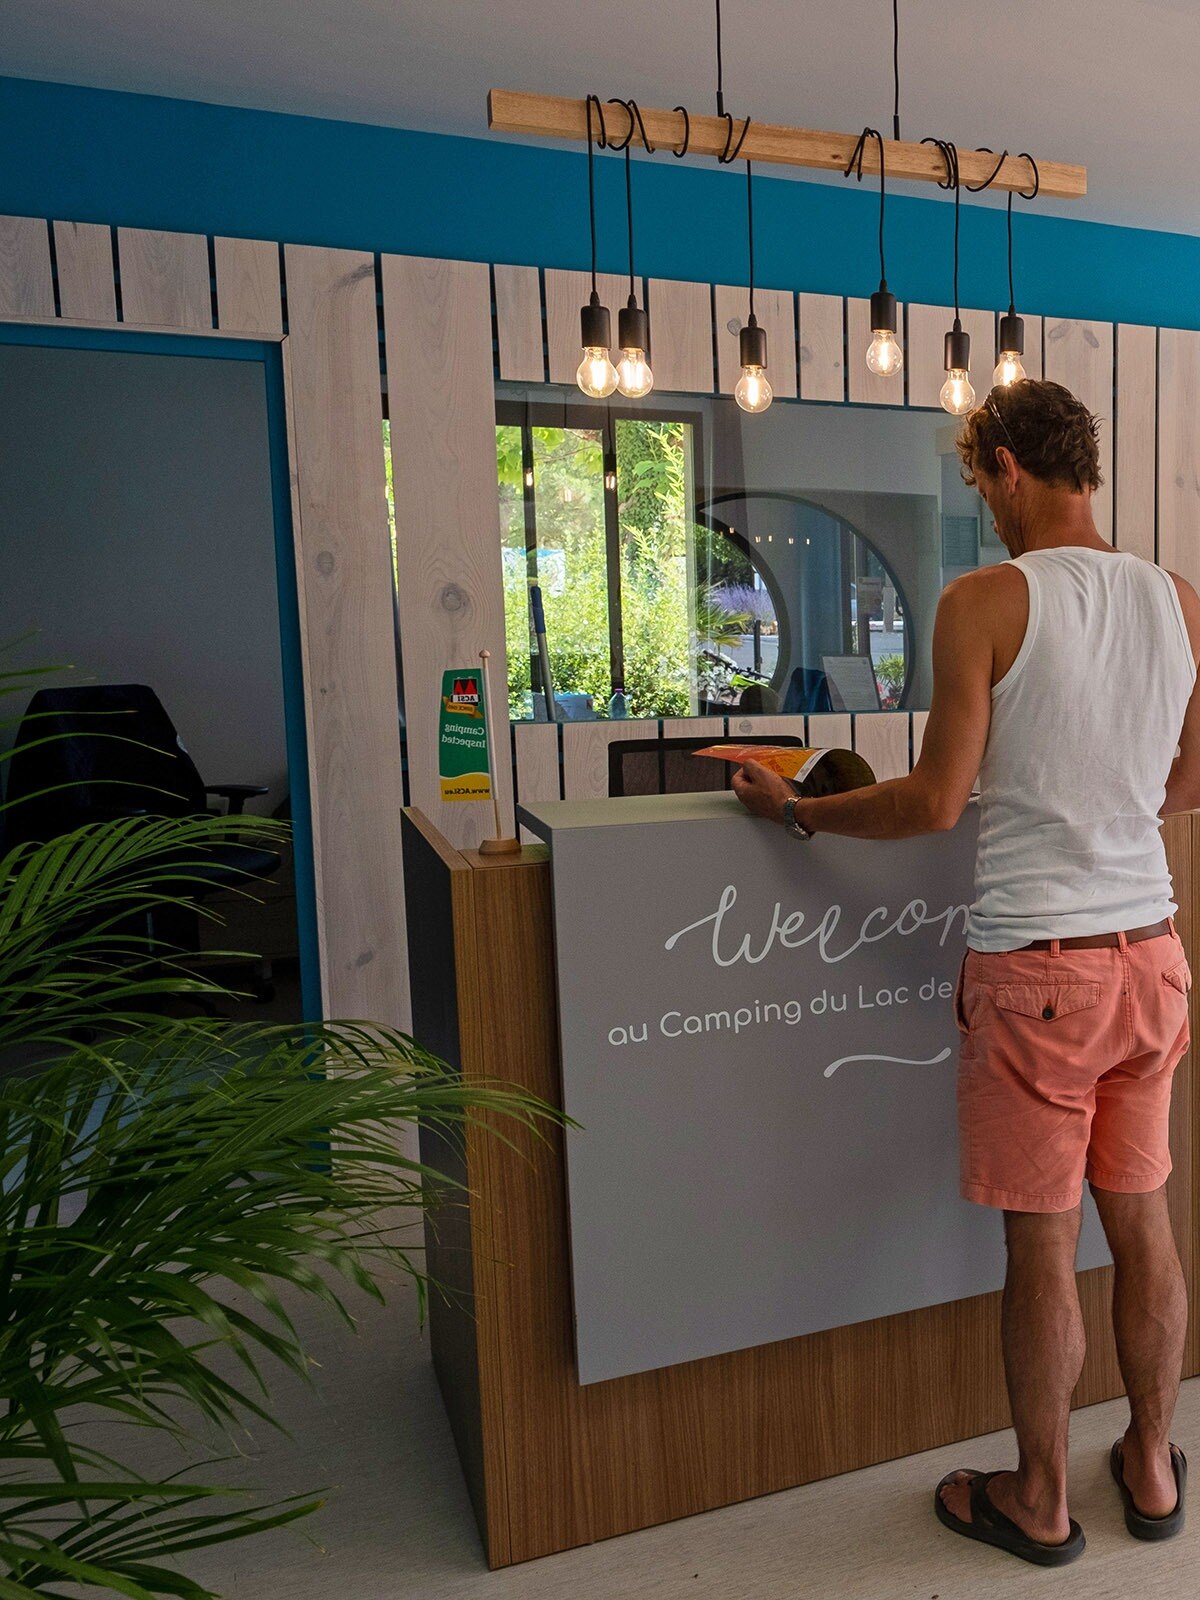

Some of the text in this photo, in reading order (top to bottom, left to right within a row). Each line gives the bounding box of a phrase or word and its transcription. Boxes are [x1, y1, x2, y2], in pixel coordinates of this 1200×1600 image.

[607, 976, 953, 1046] au Camping du Lac de
